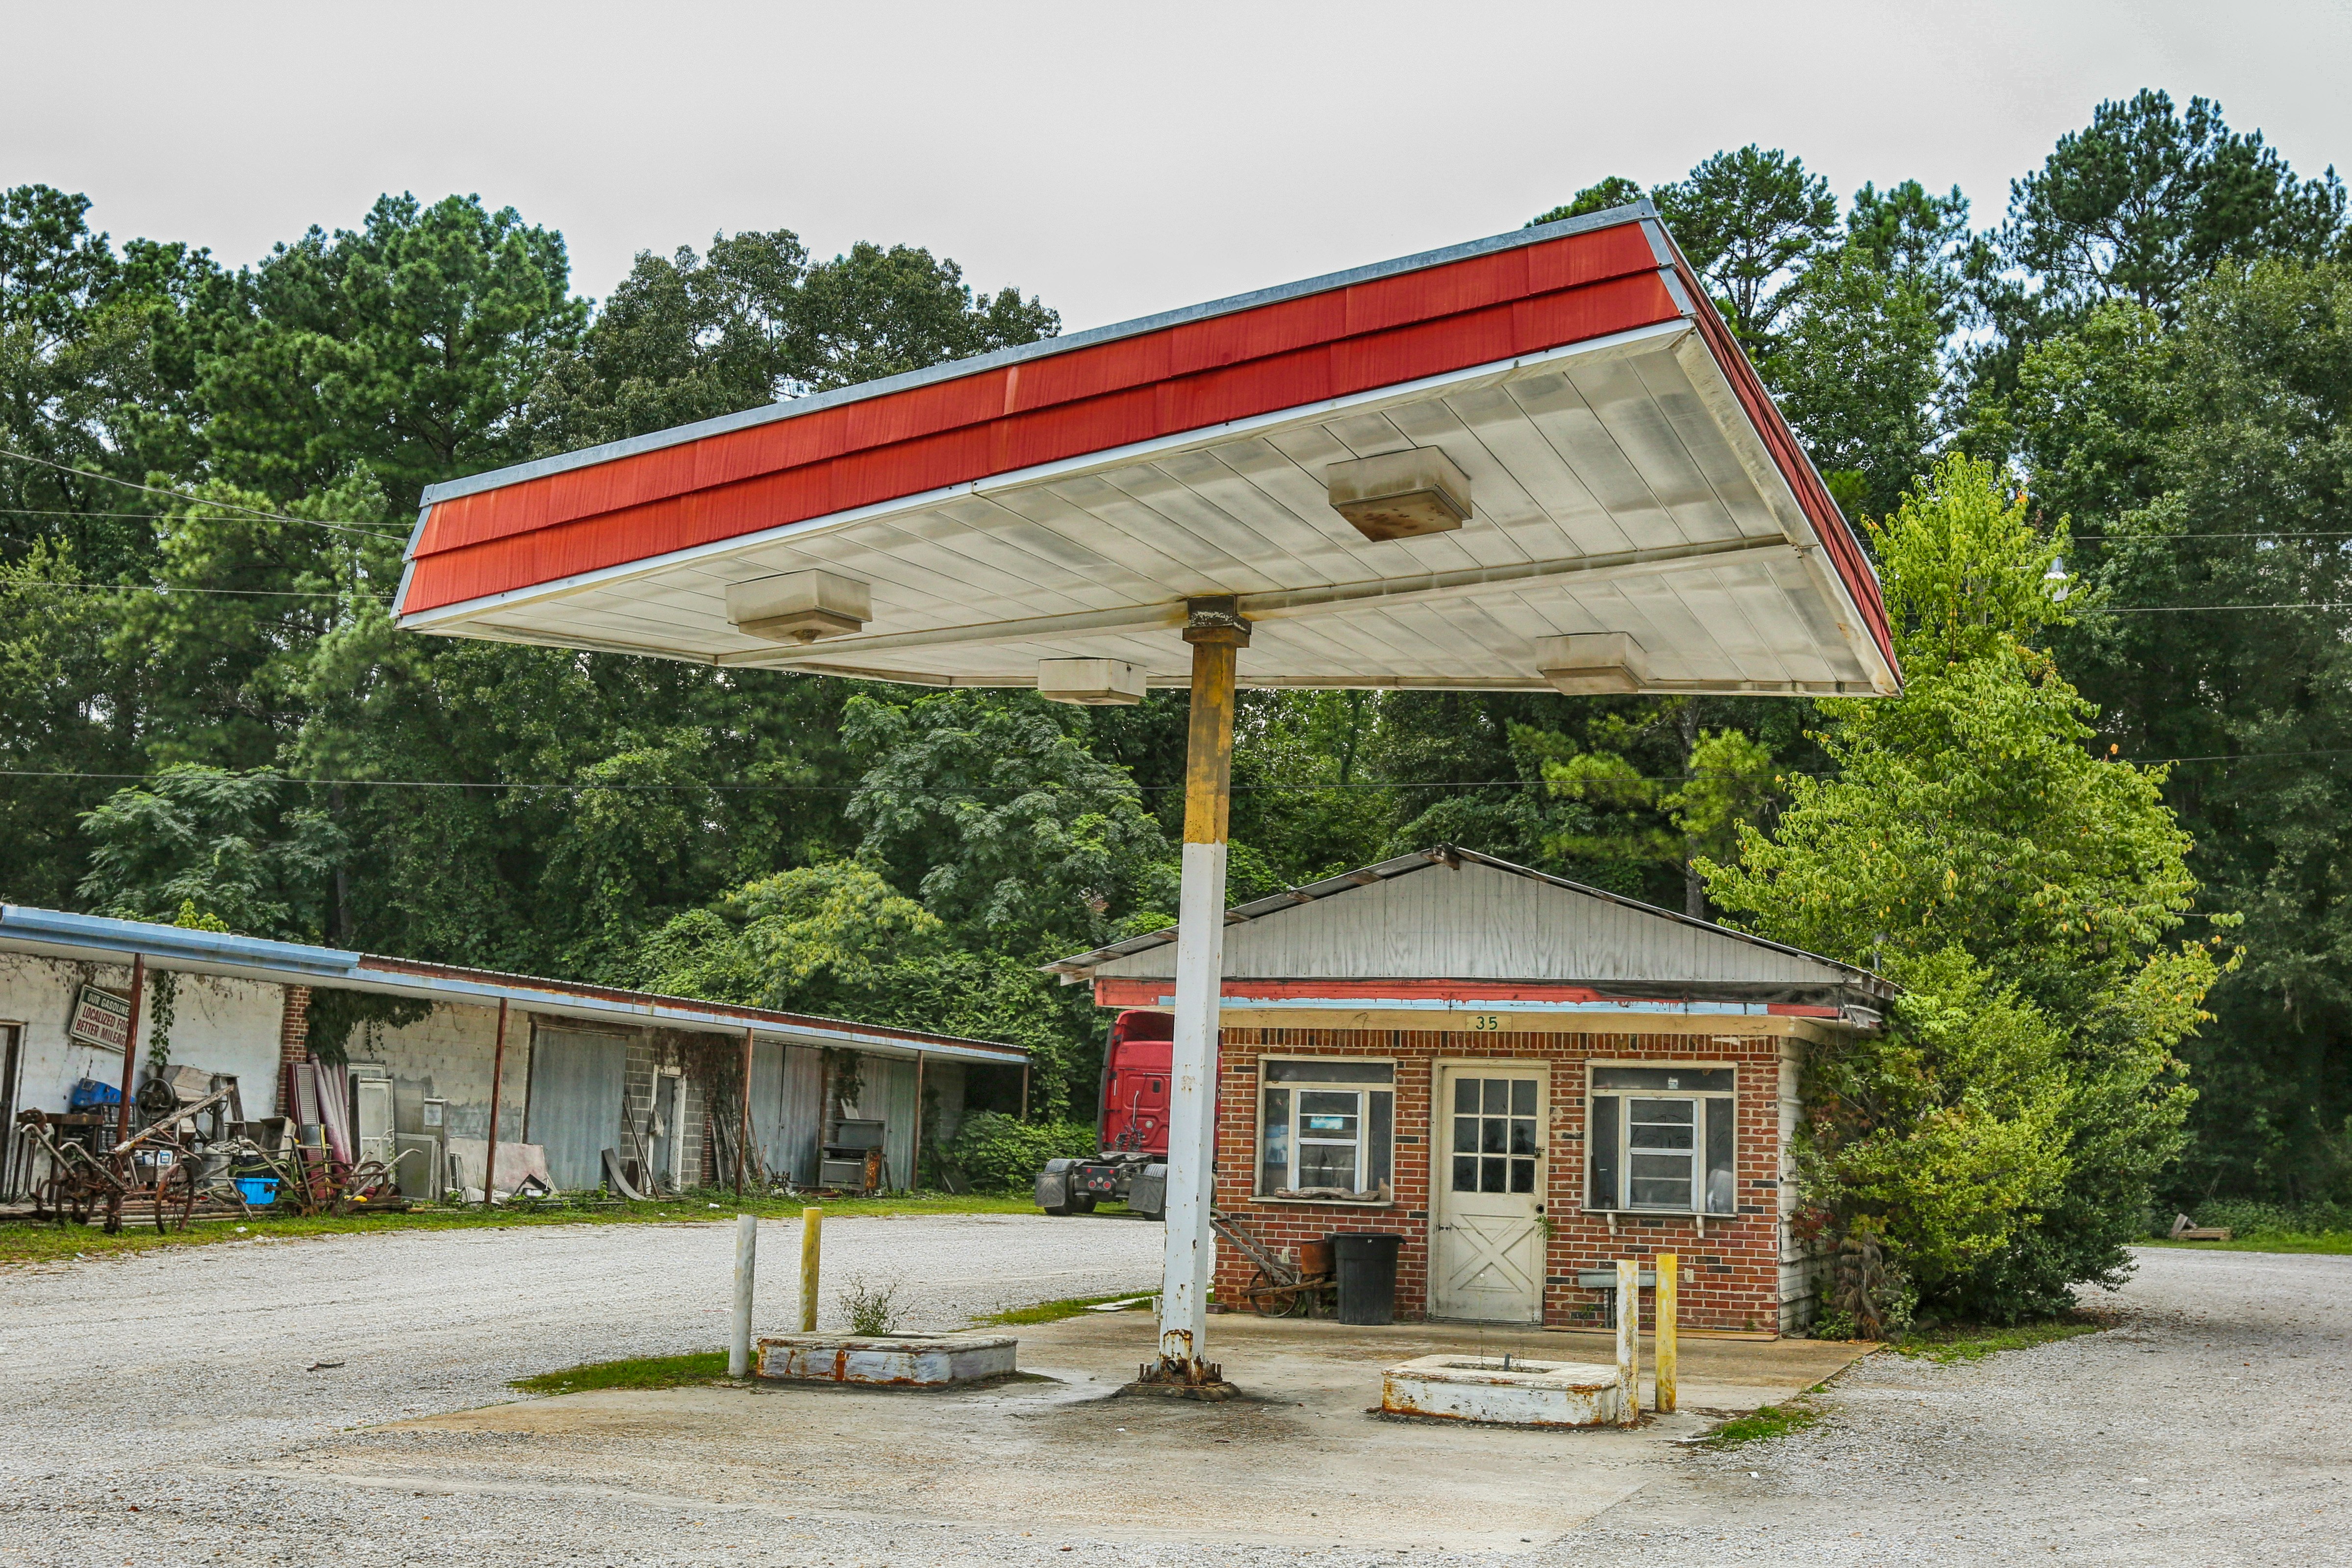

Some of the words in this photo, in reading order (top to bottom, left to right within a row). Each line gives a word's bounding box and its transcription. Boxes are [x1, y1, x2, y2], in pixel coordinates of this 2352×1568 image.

[88, 993, 101, 1005] OUR
[101, 998, 130, 1016] GASOLINE
[82, 1006, 116, 1027] LOCALIZED
[1476, 1016, 1497, 1030] 35
[76, 1019, 99, 1037] BETTER
[100, 1027, 126, 1047] MILEAG
